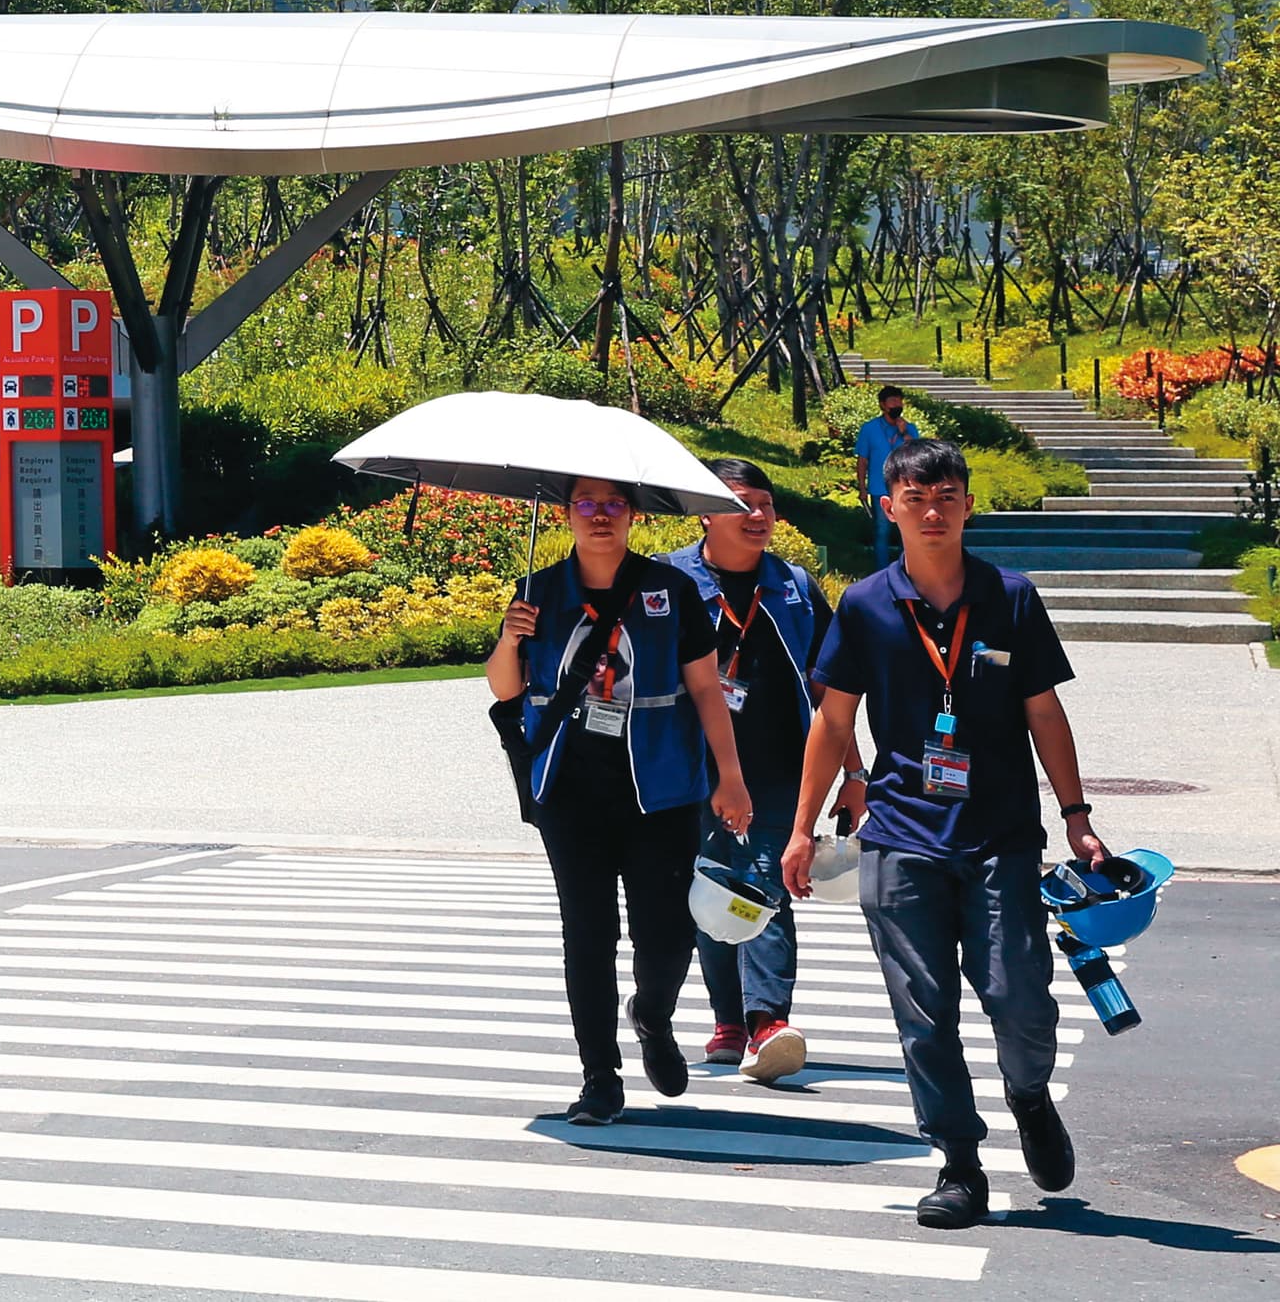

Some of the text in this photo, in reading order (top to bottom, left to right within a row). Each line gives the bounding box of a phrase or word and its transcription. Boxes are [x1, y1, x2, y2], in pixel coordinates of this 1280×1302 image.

[11, 299, 43, 353] P
[70, 299, 98, 352] P
[23, 409, 55, 429] 264
[80, 408, 108, 429] 264
[19, 456, 54, 465] Employee
